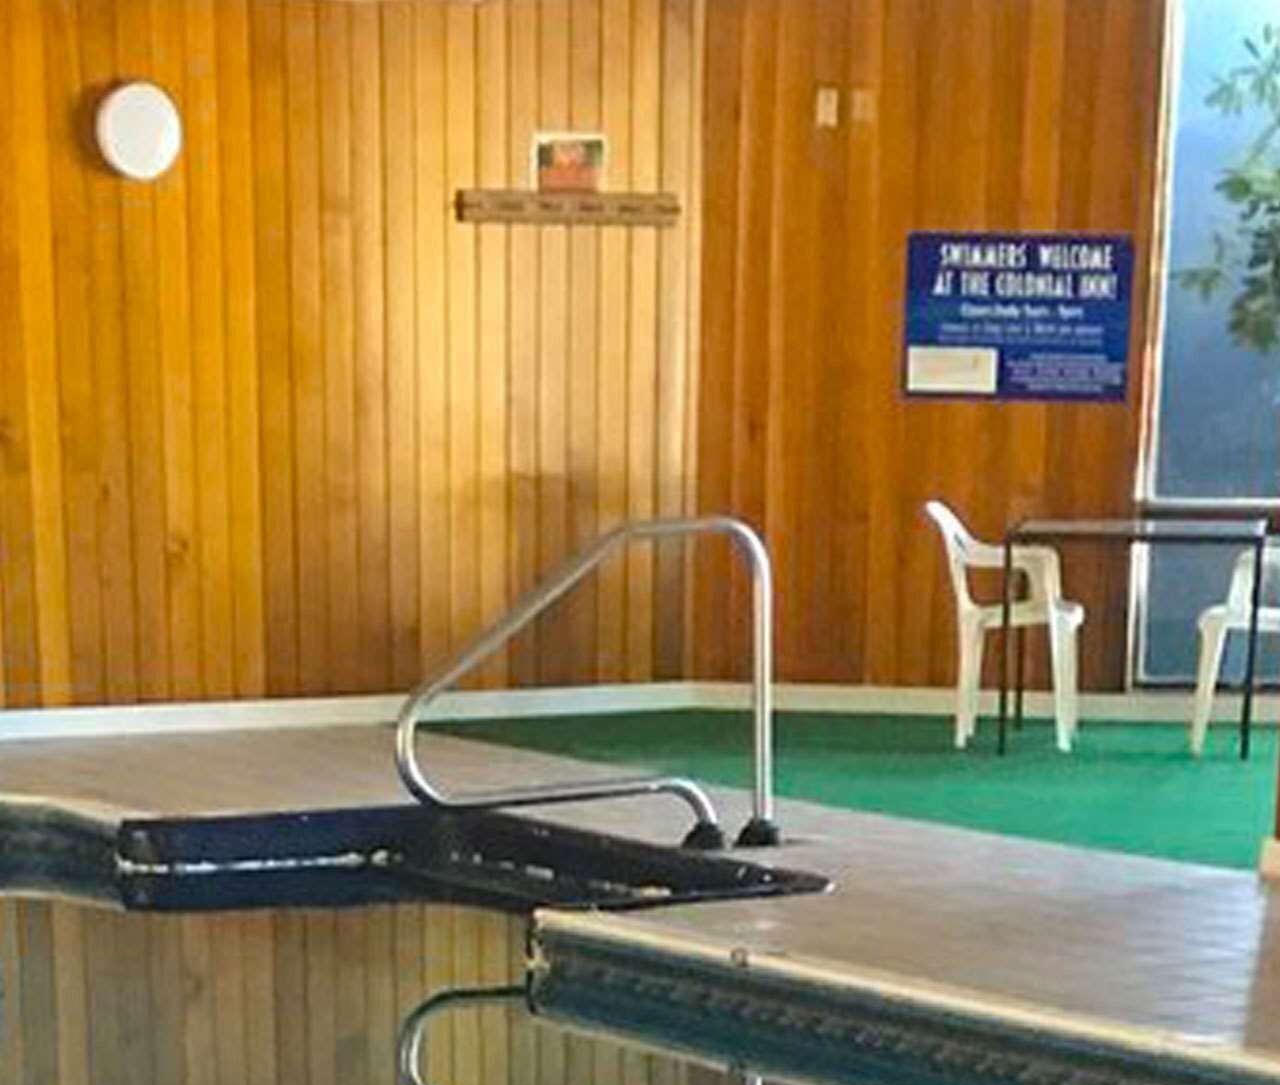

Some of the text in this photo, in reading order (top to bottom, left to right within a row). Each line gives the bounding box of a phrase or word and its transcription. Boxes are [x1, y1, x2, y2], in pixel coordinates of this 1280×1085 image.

[1039, 244, 1112, 270] WELCOME
[933, 271, 953, 296] AT
[961, 272, 990, 297] THE
